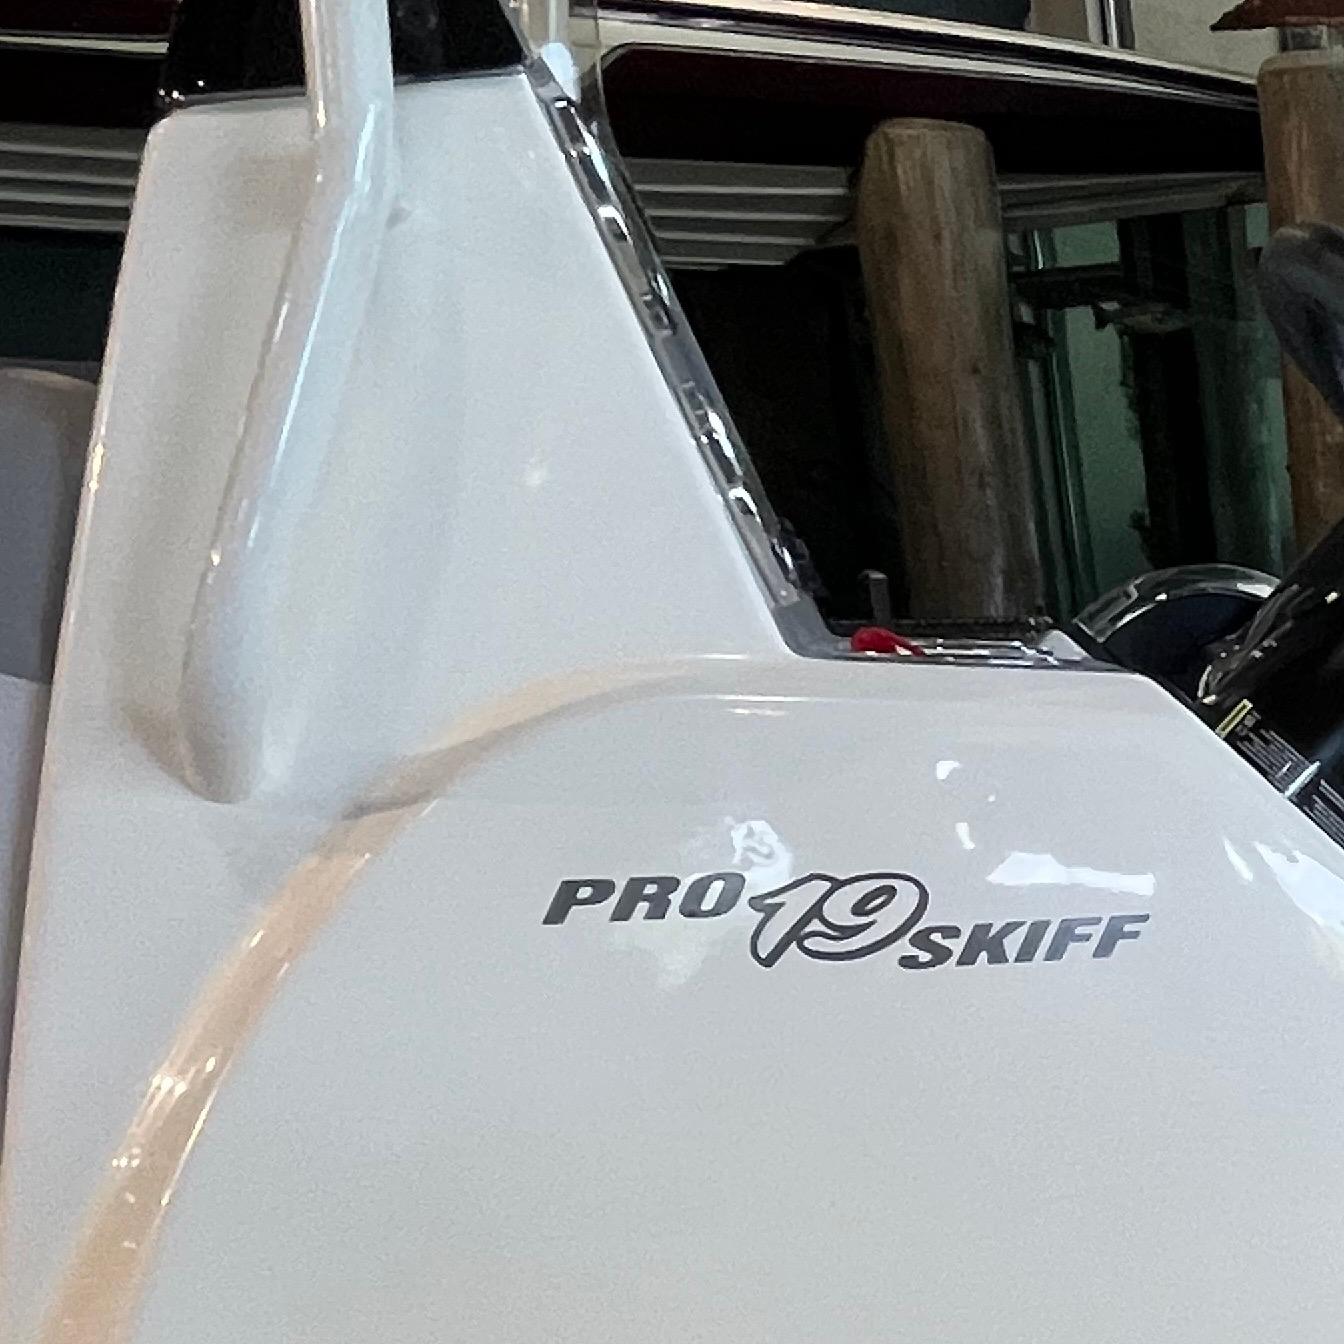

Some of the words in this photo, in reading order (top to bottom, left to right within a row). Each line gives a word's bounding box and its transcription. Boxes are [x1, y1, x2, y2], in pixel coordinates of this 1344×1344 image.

[541, 871, 746, 926] PRO
[747, 871, 930, 969] 19
[897, 912, 1151, 970] SKIFF
